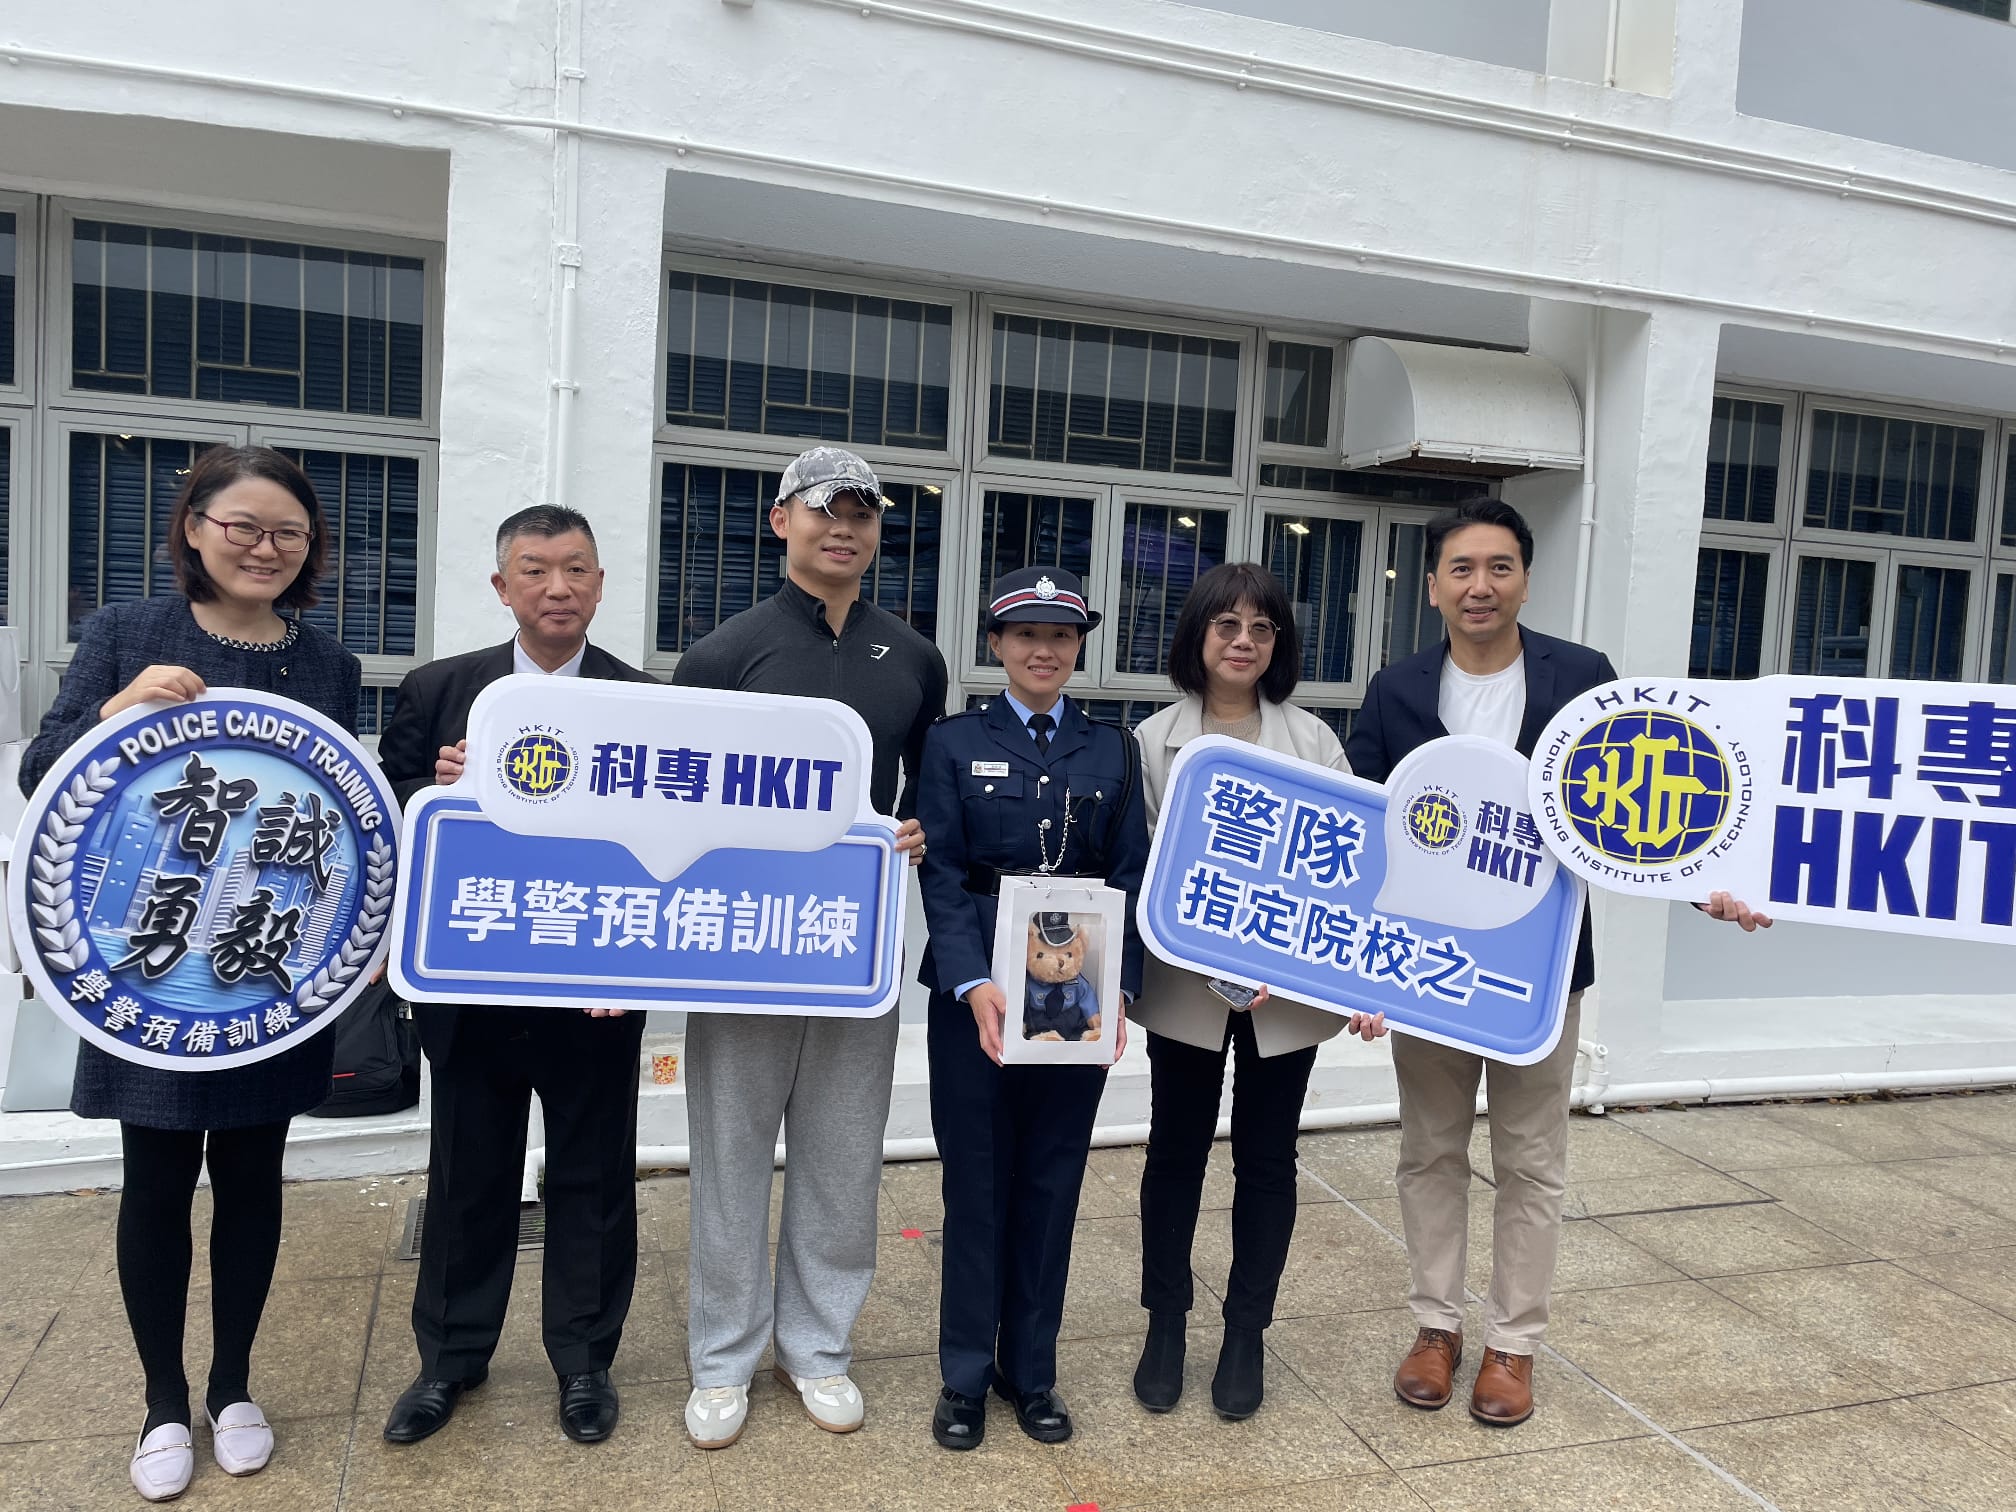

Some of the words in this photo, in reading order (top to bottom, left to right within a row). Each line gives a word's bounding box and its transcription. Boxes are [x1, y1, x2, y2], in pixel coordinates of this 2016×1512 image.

[1594, 687, 1711, 712] HKIT
[496, 741, 509, 764] HONG
[519, 725, 564, 735] HKIT
[1542, 730, 1571, 782] HONG
[1781, 693, 2016, 809] 科專
[119, 709, 219, 766] POLICE
[225, 709, 309, 751] CADET
[309, 735, 384, 832] TRAINING
[496, 767, 508, 789] KONG
[561, 746, 579, 793] TECHNOLOGY
[589, 742, 713, 803] 科專
[721, 752, 843, 812] HKIT
[1424, 785, 1459, 799] HKIT
[508, 789, 549, 804] INSTITUTE
[551, 794, 560, 802] OF
[1542, 791, 1570, 843] KONG
[1707, 740, 1752, 859] TECHNOLOGY
[1205, 775, 1363, 887] 警隊
[1475, 800, 1544, 850] 科專
[1467, 836, 1543, 888] HKIT
[1571, 845, 1672, 883] INSTITUTE
[1680, 859, 1703, 878] OF
[1769, 804, 2016, 927] HKIT
[448, 875, 860, 959] 學警預備訓練
[1179, 863, 1532, 1004] 指定院校之一
[68, 967, 299, 1053] 學警預備訓練
